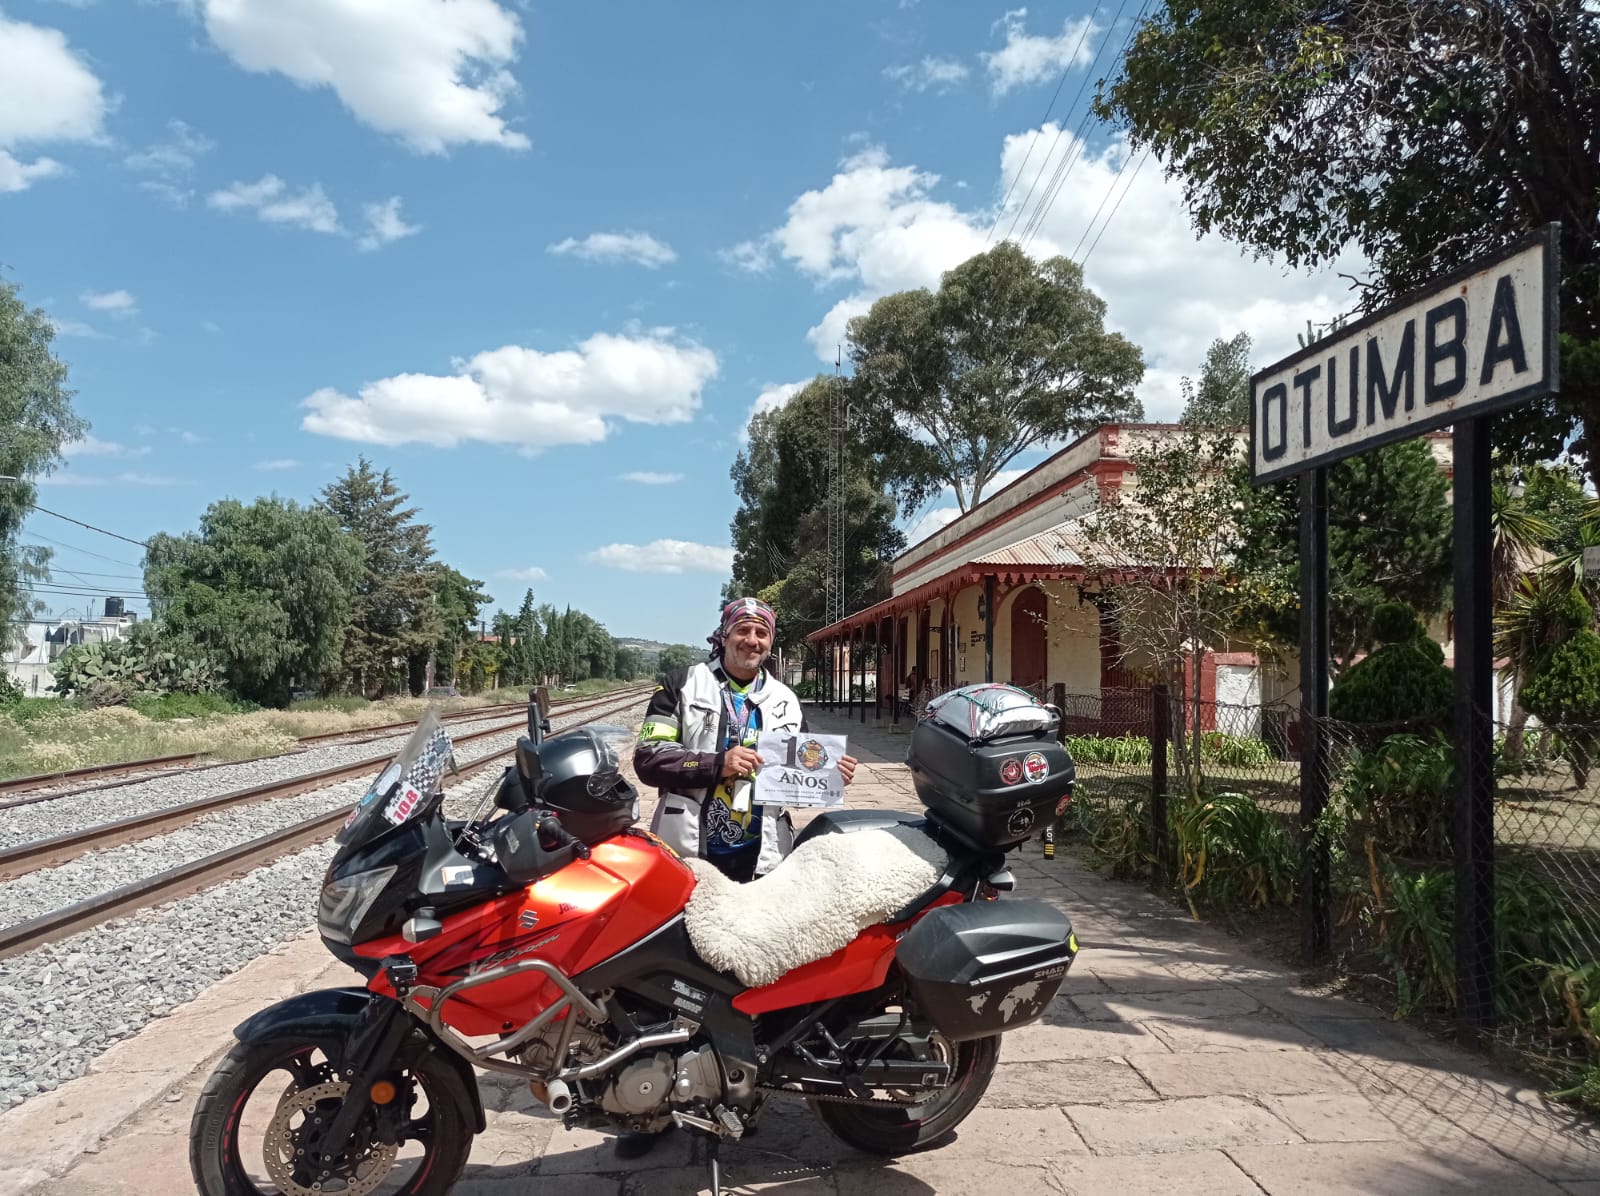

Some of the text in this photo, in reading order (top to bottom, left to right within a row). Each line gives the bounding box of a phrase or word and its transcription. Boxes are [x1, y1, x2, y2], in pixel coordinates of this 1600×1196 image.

[1262, 275, 1528, 463] OTUMBA
[778, 770, 828, 790] AÑOS
[393, 789, 418, 822] 108
[1034, 965, 1065, 978] SHAD
